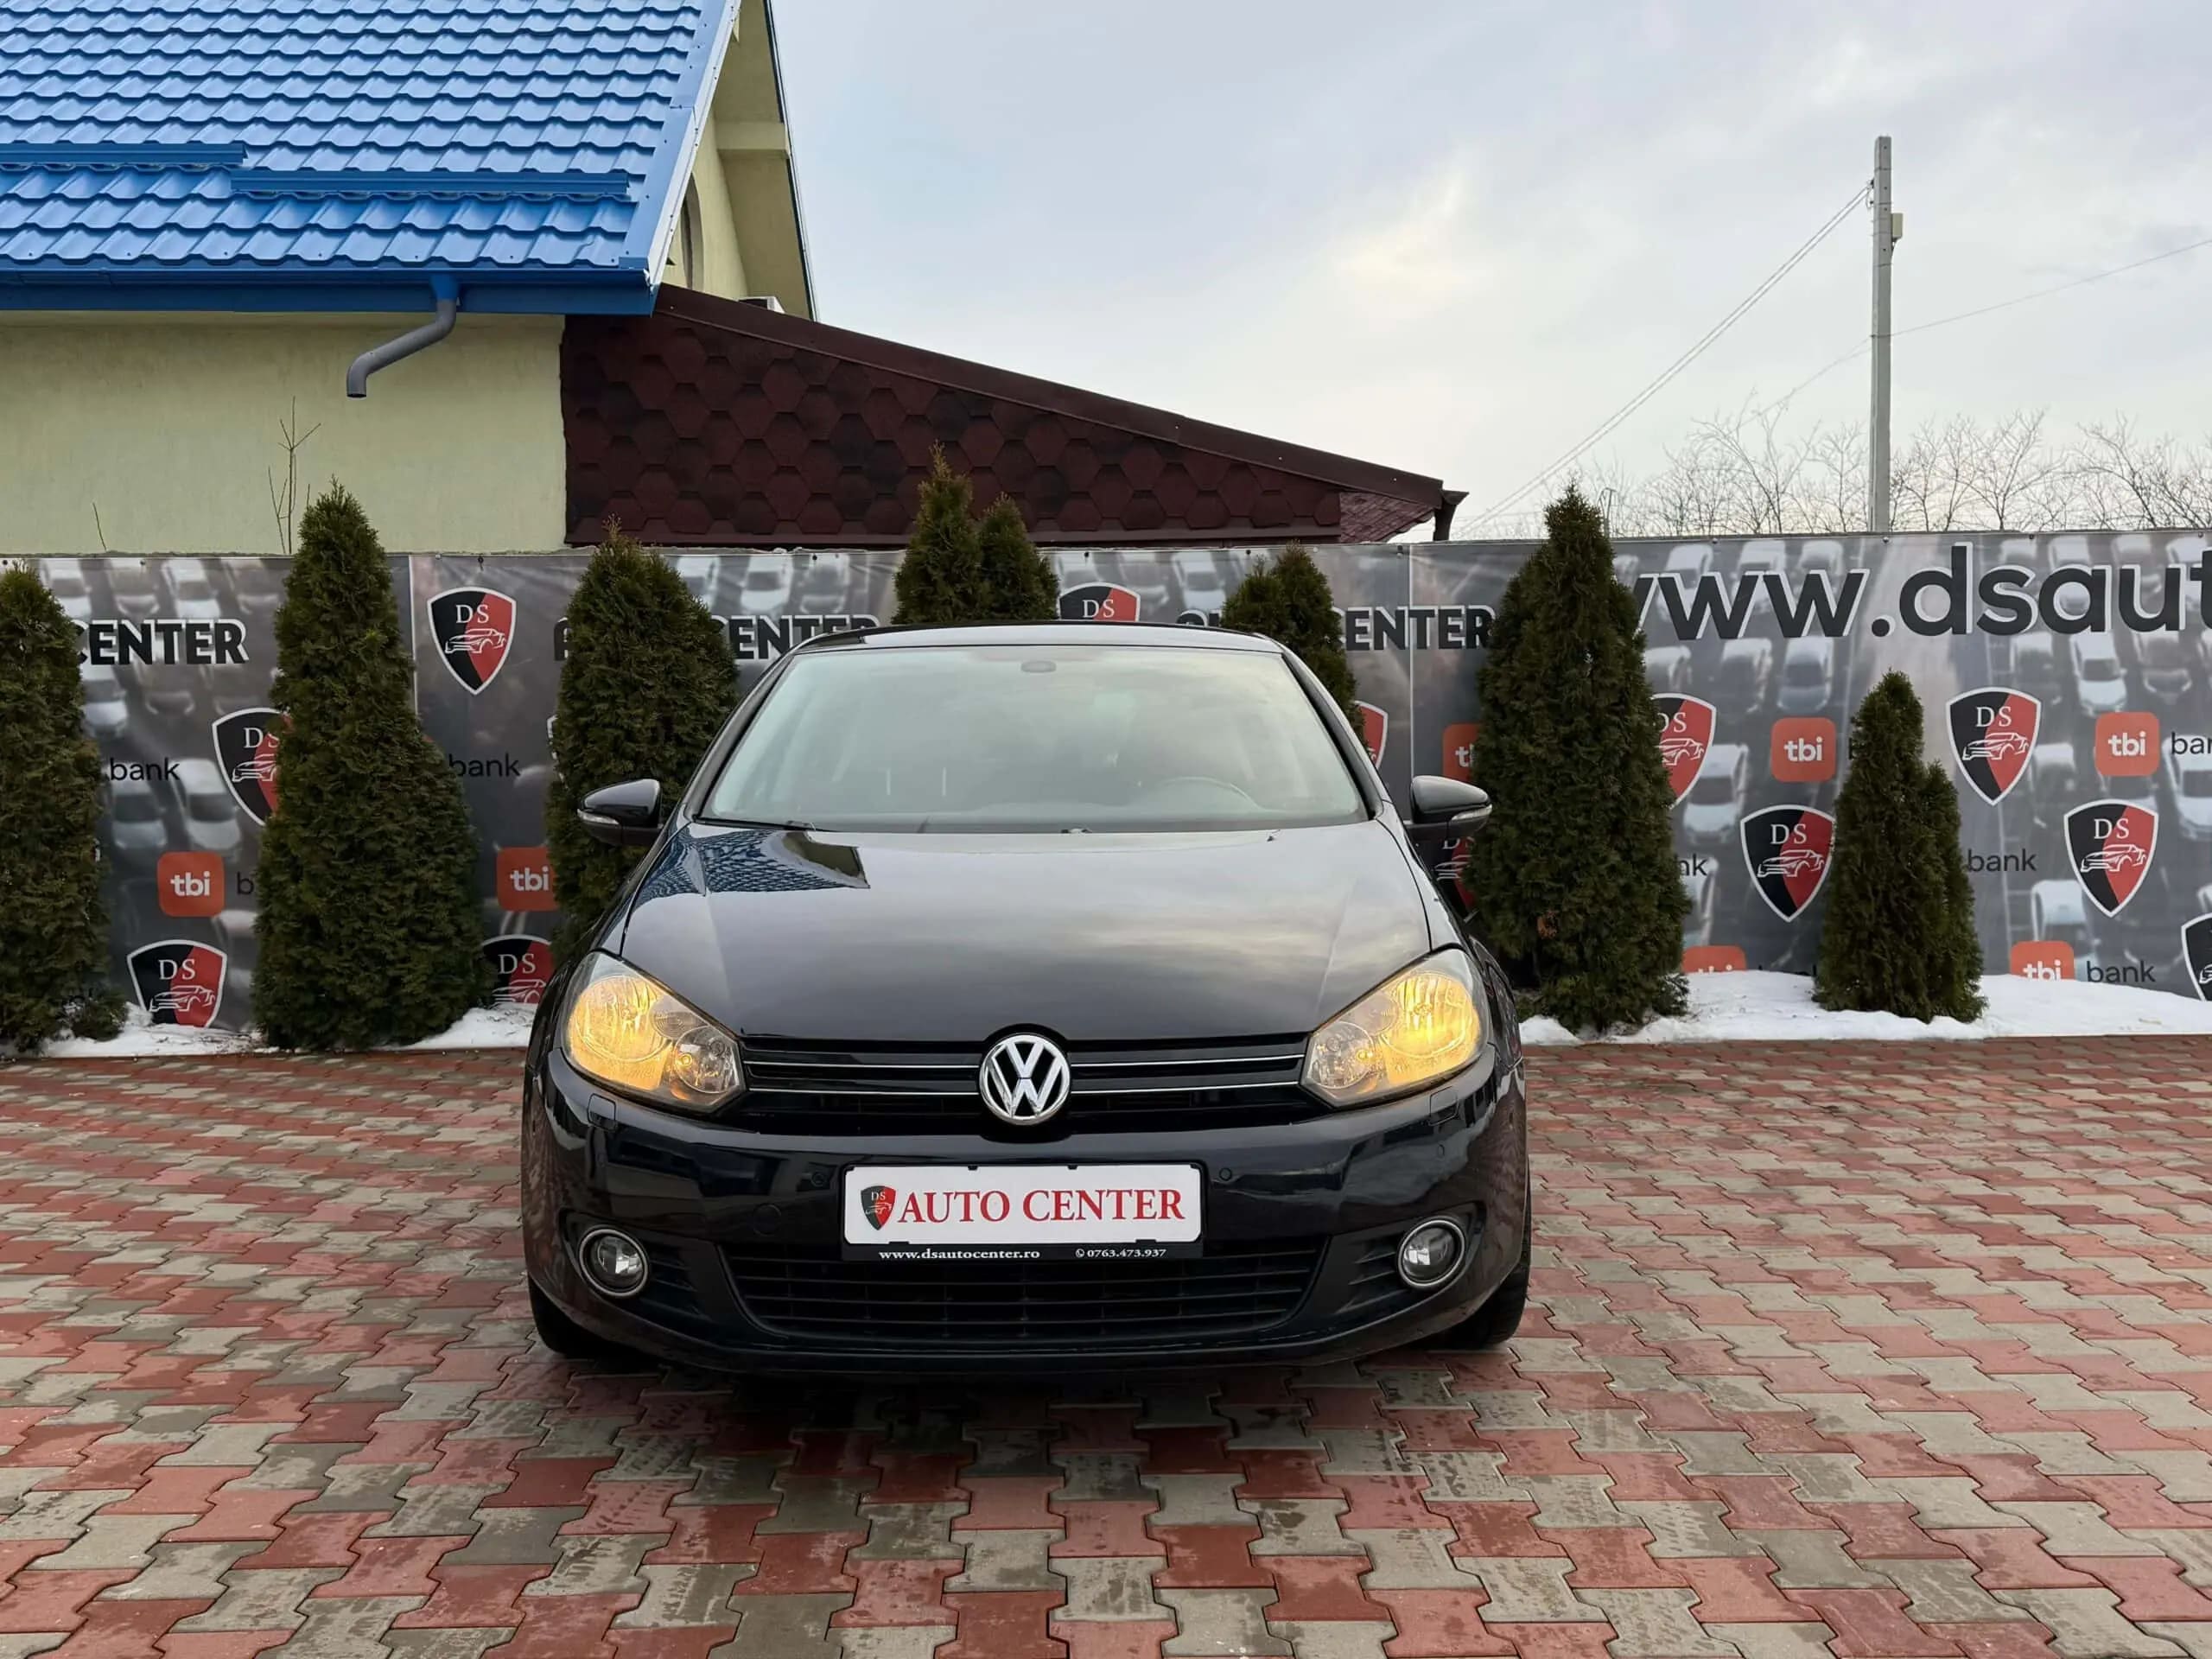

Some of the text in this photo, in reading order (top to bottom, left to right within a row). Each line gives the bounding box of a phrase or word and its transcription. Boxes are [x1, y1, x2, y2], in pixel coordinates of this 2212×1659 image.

[456, 604, 490, 624] DS
[1082, 599, 1115, 618] DS
[1334, 606, 1496, 650] ENTER
[1976, 706, 2012, 728] DS
[1783, 736, 1823, 762] tbi
[2108, 731, 2145, 756] tbi
[110, 757, 180, 781] bank
[448, 753, 521, 777] bank
[1770, 823, 1807, 844] DS
[2094, 818, 2130, 839] DS
[1967, 849, 2037, 872] bank
[170, 871, 210, 897] tbi
[510, 866, 550, 892] tbi
[159, 958, 196, 980] DS
[498, 953, 537, 975] DS
[2023, 959, 2156, 982] tbi bank
[871, 1191, 886, 1201] DS
[897, 1189, 1185, 1224] AUTO CENTER
[879, 1248, 1166, 1259] www.dsautocenter.ro 0763.473.937
